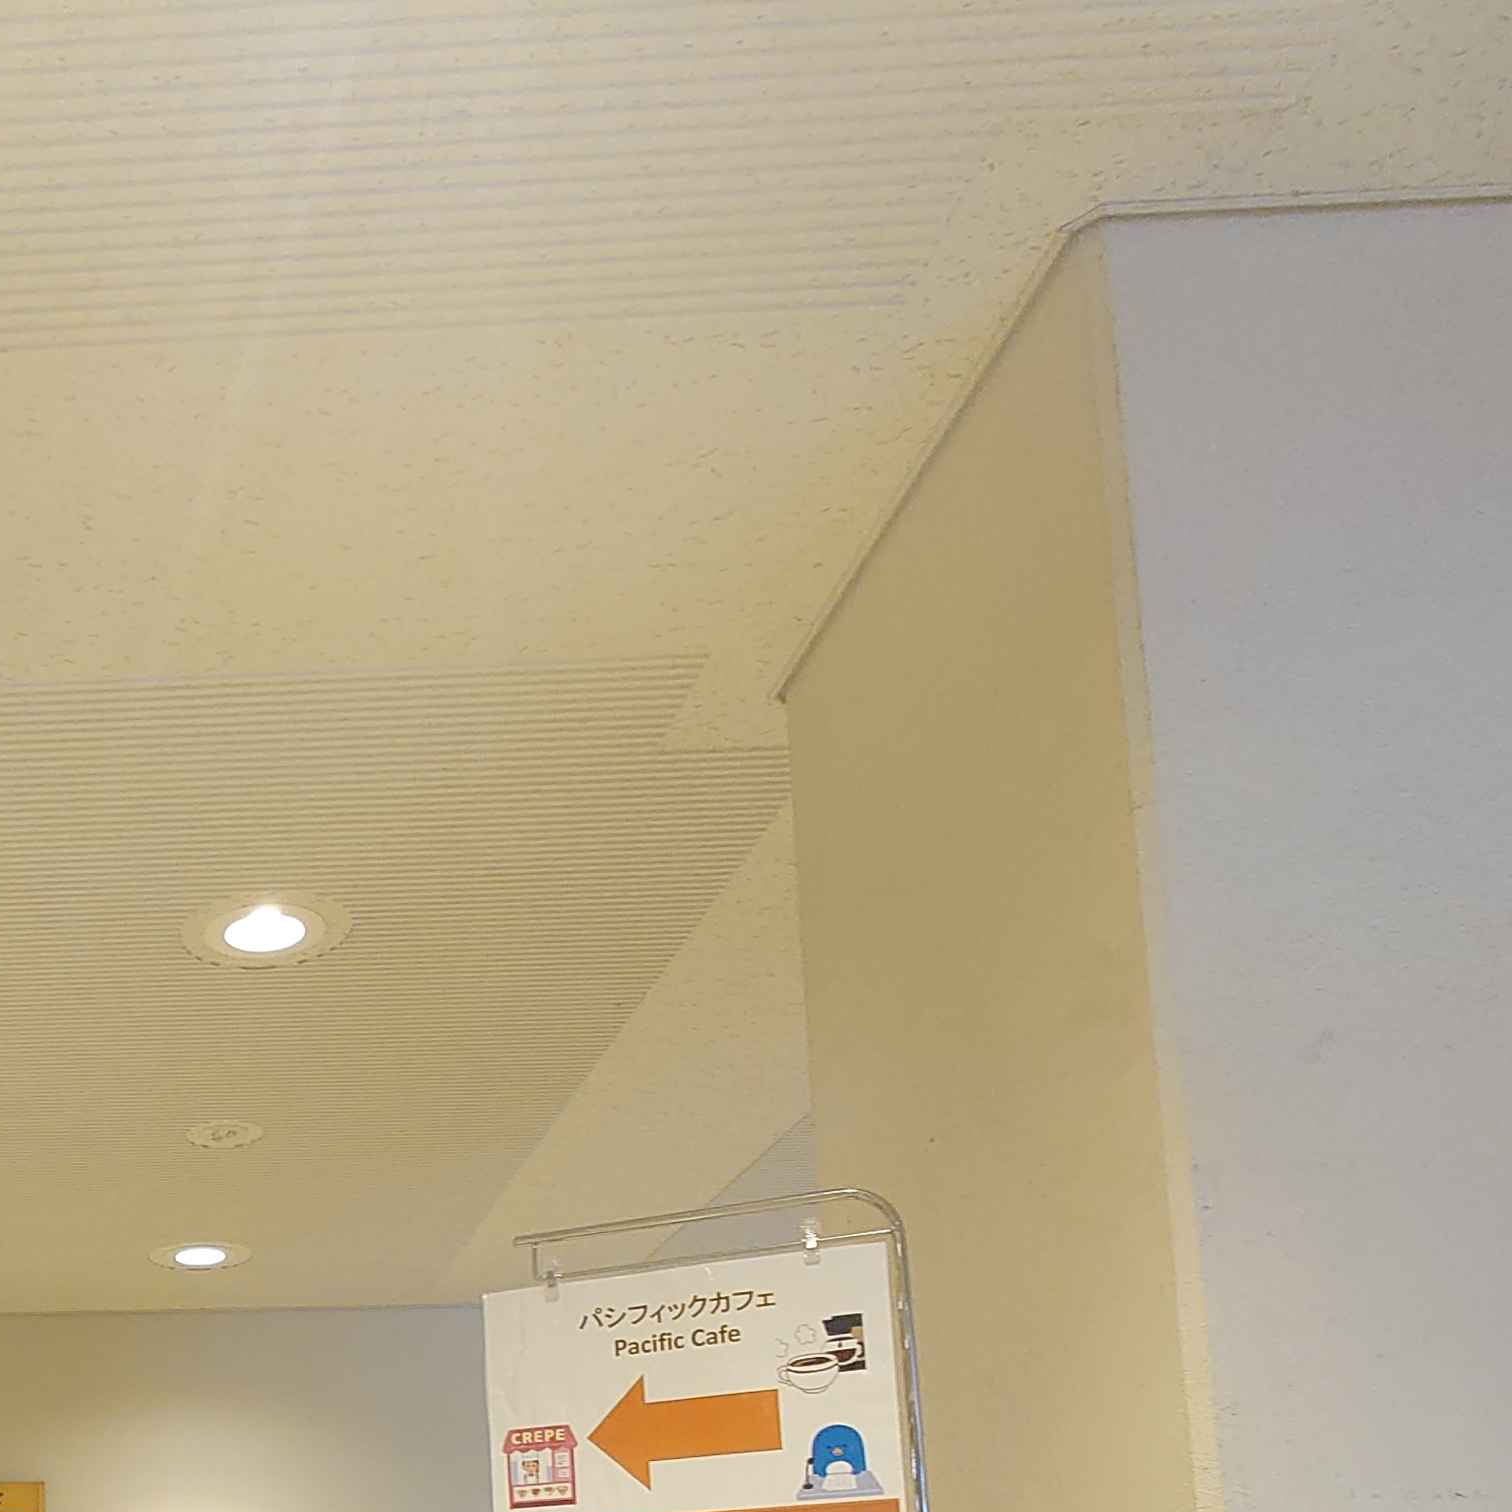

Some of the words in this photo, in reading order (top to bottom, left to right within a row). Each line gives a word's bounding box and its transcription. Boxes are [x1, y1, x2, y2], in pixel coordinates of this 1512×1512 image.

[579, 1288, 777, 1330] パシフィックカフェ
[614, 1331, 685, 1357] Pacific
[691, 1325, 741, 1347] Cafe
[510, 1427, 566, 1446] CREPE
